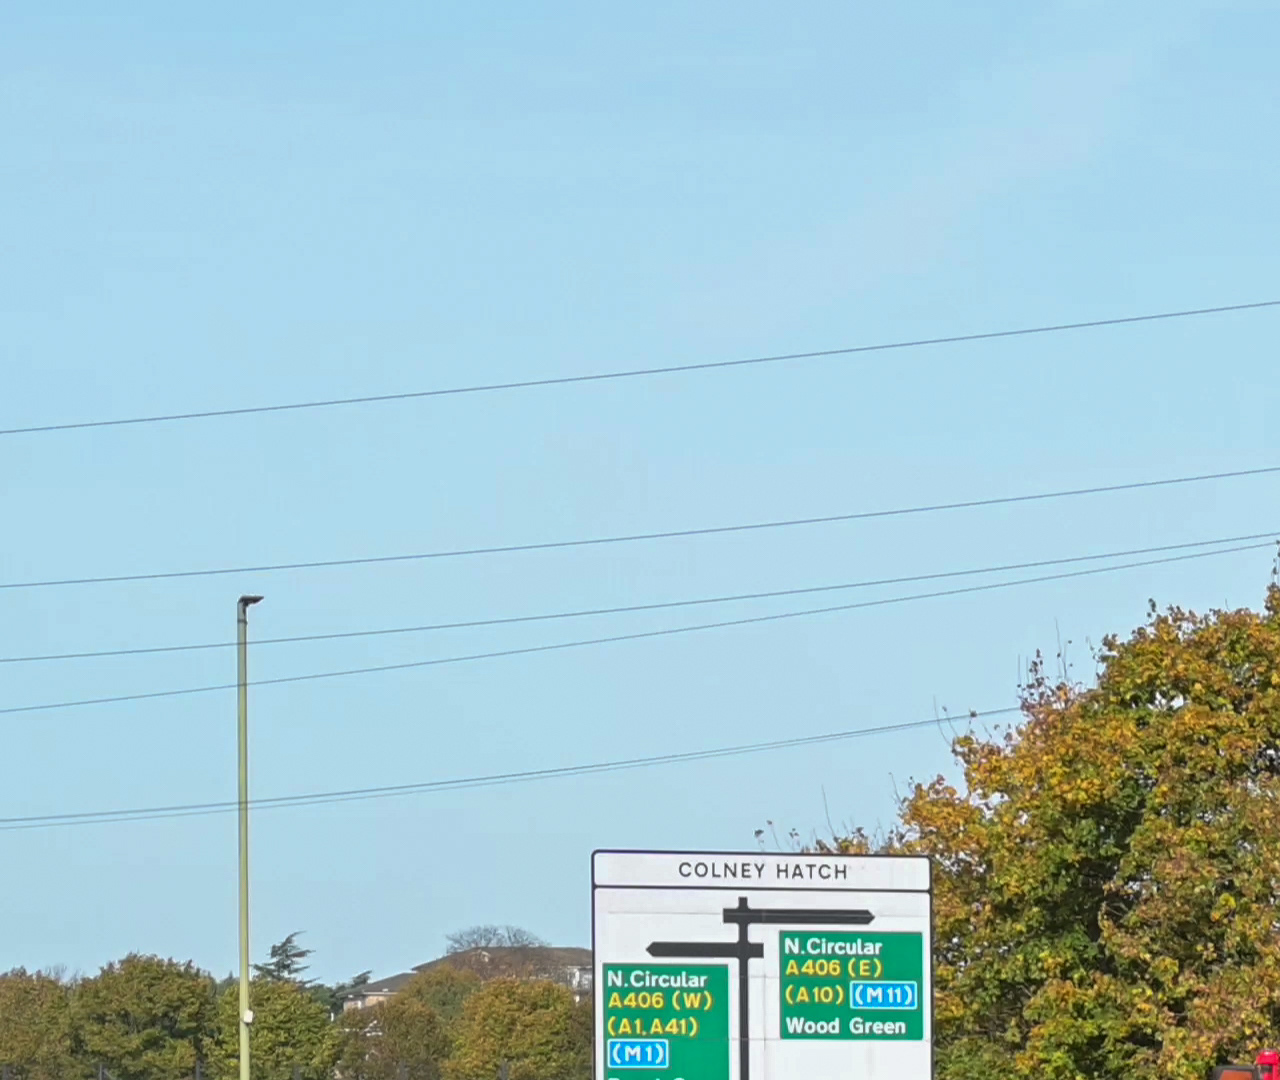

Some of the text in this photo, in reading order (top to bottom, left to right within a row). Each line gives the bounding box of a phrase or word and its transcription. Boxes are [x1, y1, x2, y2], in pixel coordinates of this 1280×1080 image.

[678, 861, 847, 880] COLNEY HATCH
[784, 937, 883, 955] N.Circular
[785, 957, 882, 978] A406 (E)
[607, 969, 708, 987] N.Circular
[608, 990, 713, 1011] A406 (W)
[785, 984, 913, 1006] (A10) (M11)
[786, 1016, 907, 1035] Wood Green
[612, 1042, 665, 1065] (M1)
